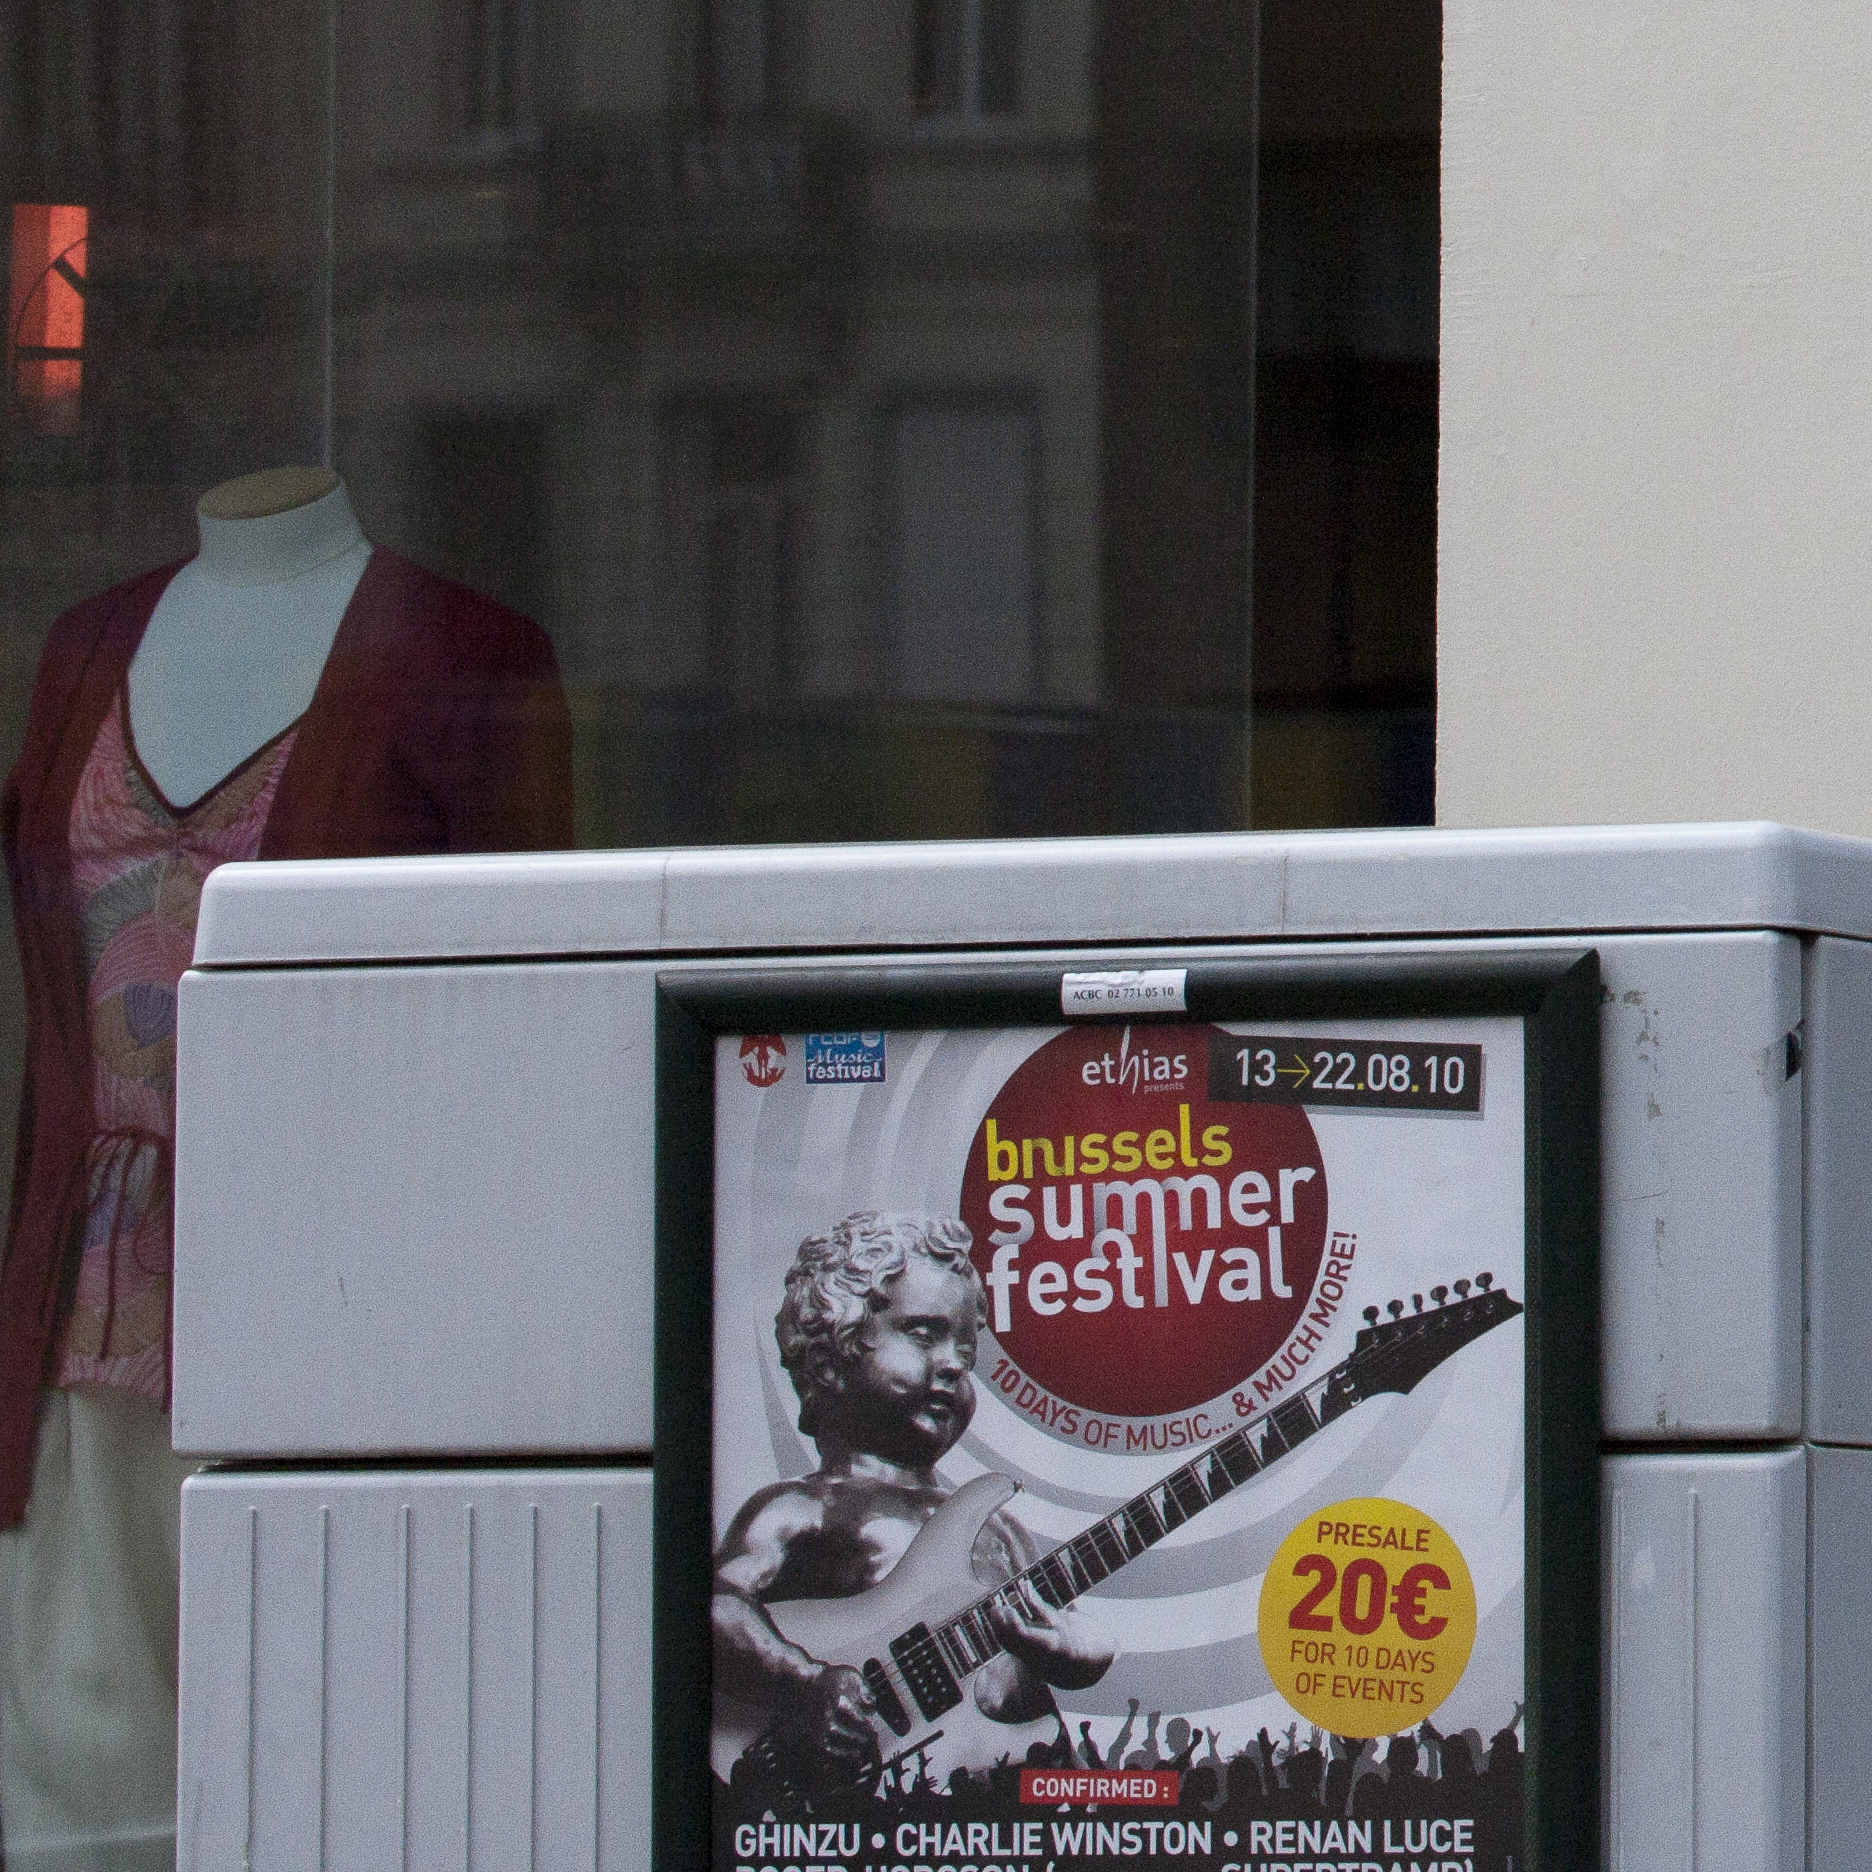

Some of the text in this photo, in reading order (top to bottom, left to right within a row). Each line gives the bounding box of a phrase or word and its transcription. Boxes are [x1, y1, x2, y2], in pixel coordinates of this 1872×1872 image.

[1107, 988, 1120, 999] 02
[1123, 987, 1141, 997] 771
[1145, 987, 1158, 998] 05
[1162, 986, 1174, 996] 10
[807, 1048, 883, 1064] Music
[808, 1061, 882, 1080] festival
[1081, 1024, 1188, 1095] ethias
[1235, 1048, 1465, 1095] 13 22.08.10
[1143, 1081, 1185, 1095] presents
[986, 1103, 1233, 1182] brussels
[987, 1166, 1316, 1246] summer
[986, 1226, 1293, 1333] festival
[989, 1358, 1023, 1396] 10
[1015, 1380, 1082, 1436] DAYS
[1084, 1417, 1121, 1451] OF
[1231, 1390, 1259, 1417] &
[1251, 1325, 1323, 1403] MUCH
[1309, 1229, 1358, 1329] MORE!
[1317, 1521, 1431, 1552] PRESALE
[1289, 1553, 1451, 1641] 20€
[1290, 1640, 1435, 1674] FOR 10 DAYS
[1295, 1671, 1425, 1705] OF EVENTS
[734, 1819, 1475, 1857] GHINZU CHARLIE WINSTON RENAN LUCE
